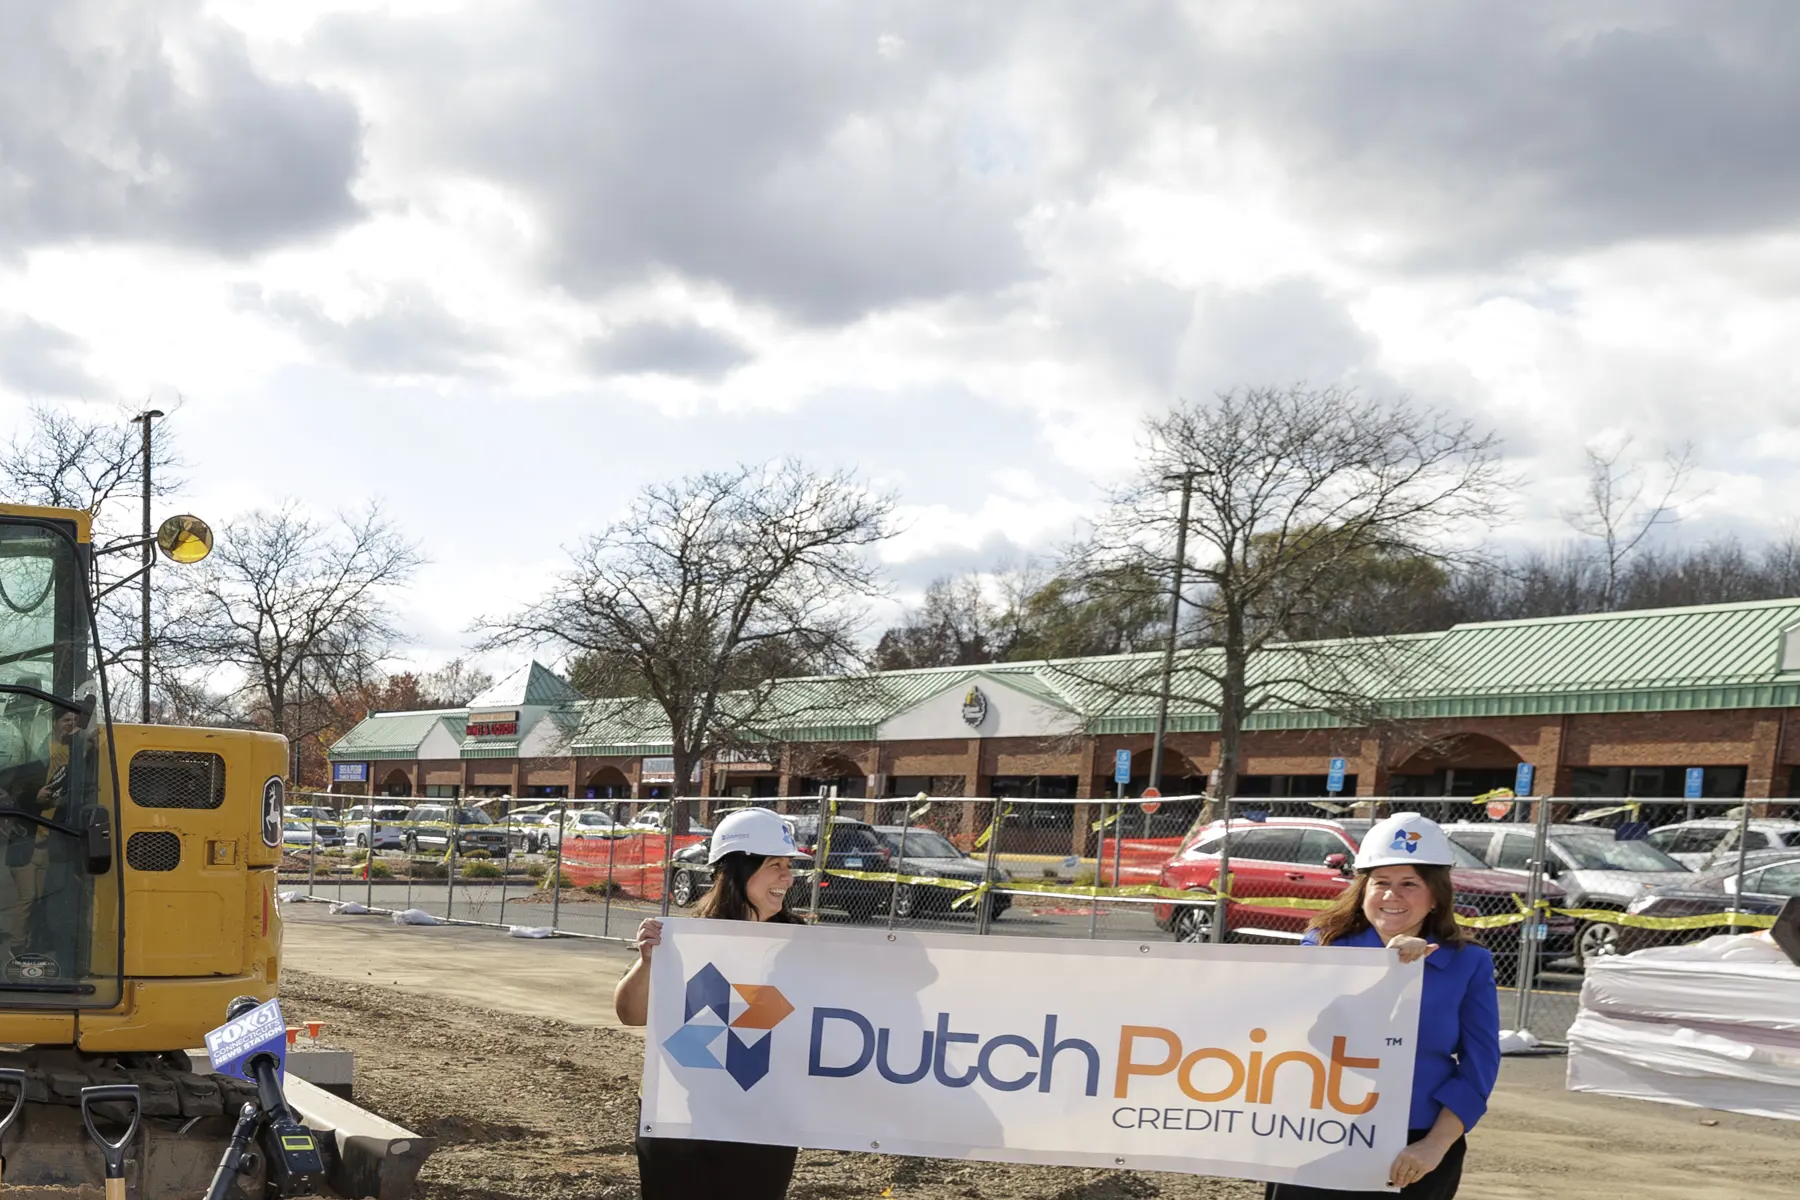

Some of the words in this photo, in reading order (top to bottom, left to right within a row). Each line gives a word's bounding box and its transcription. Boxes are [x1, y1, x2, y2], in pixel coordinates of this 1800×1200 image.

[213, 1019, 280, 1058] CONNECTICUT'S
[214, 1046, 243, 1066] NEWS
[243, 1025, 283, 1051] STATION
[808, 1006, 1100, 1097] Dutch
[1113, 1025, 1380, 1115] Point
[1112, 1106, 1244, 1134] CREDIT
[1251, 1111, 1377, 1149] UNION
